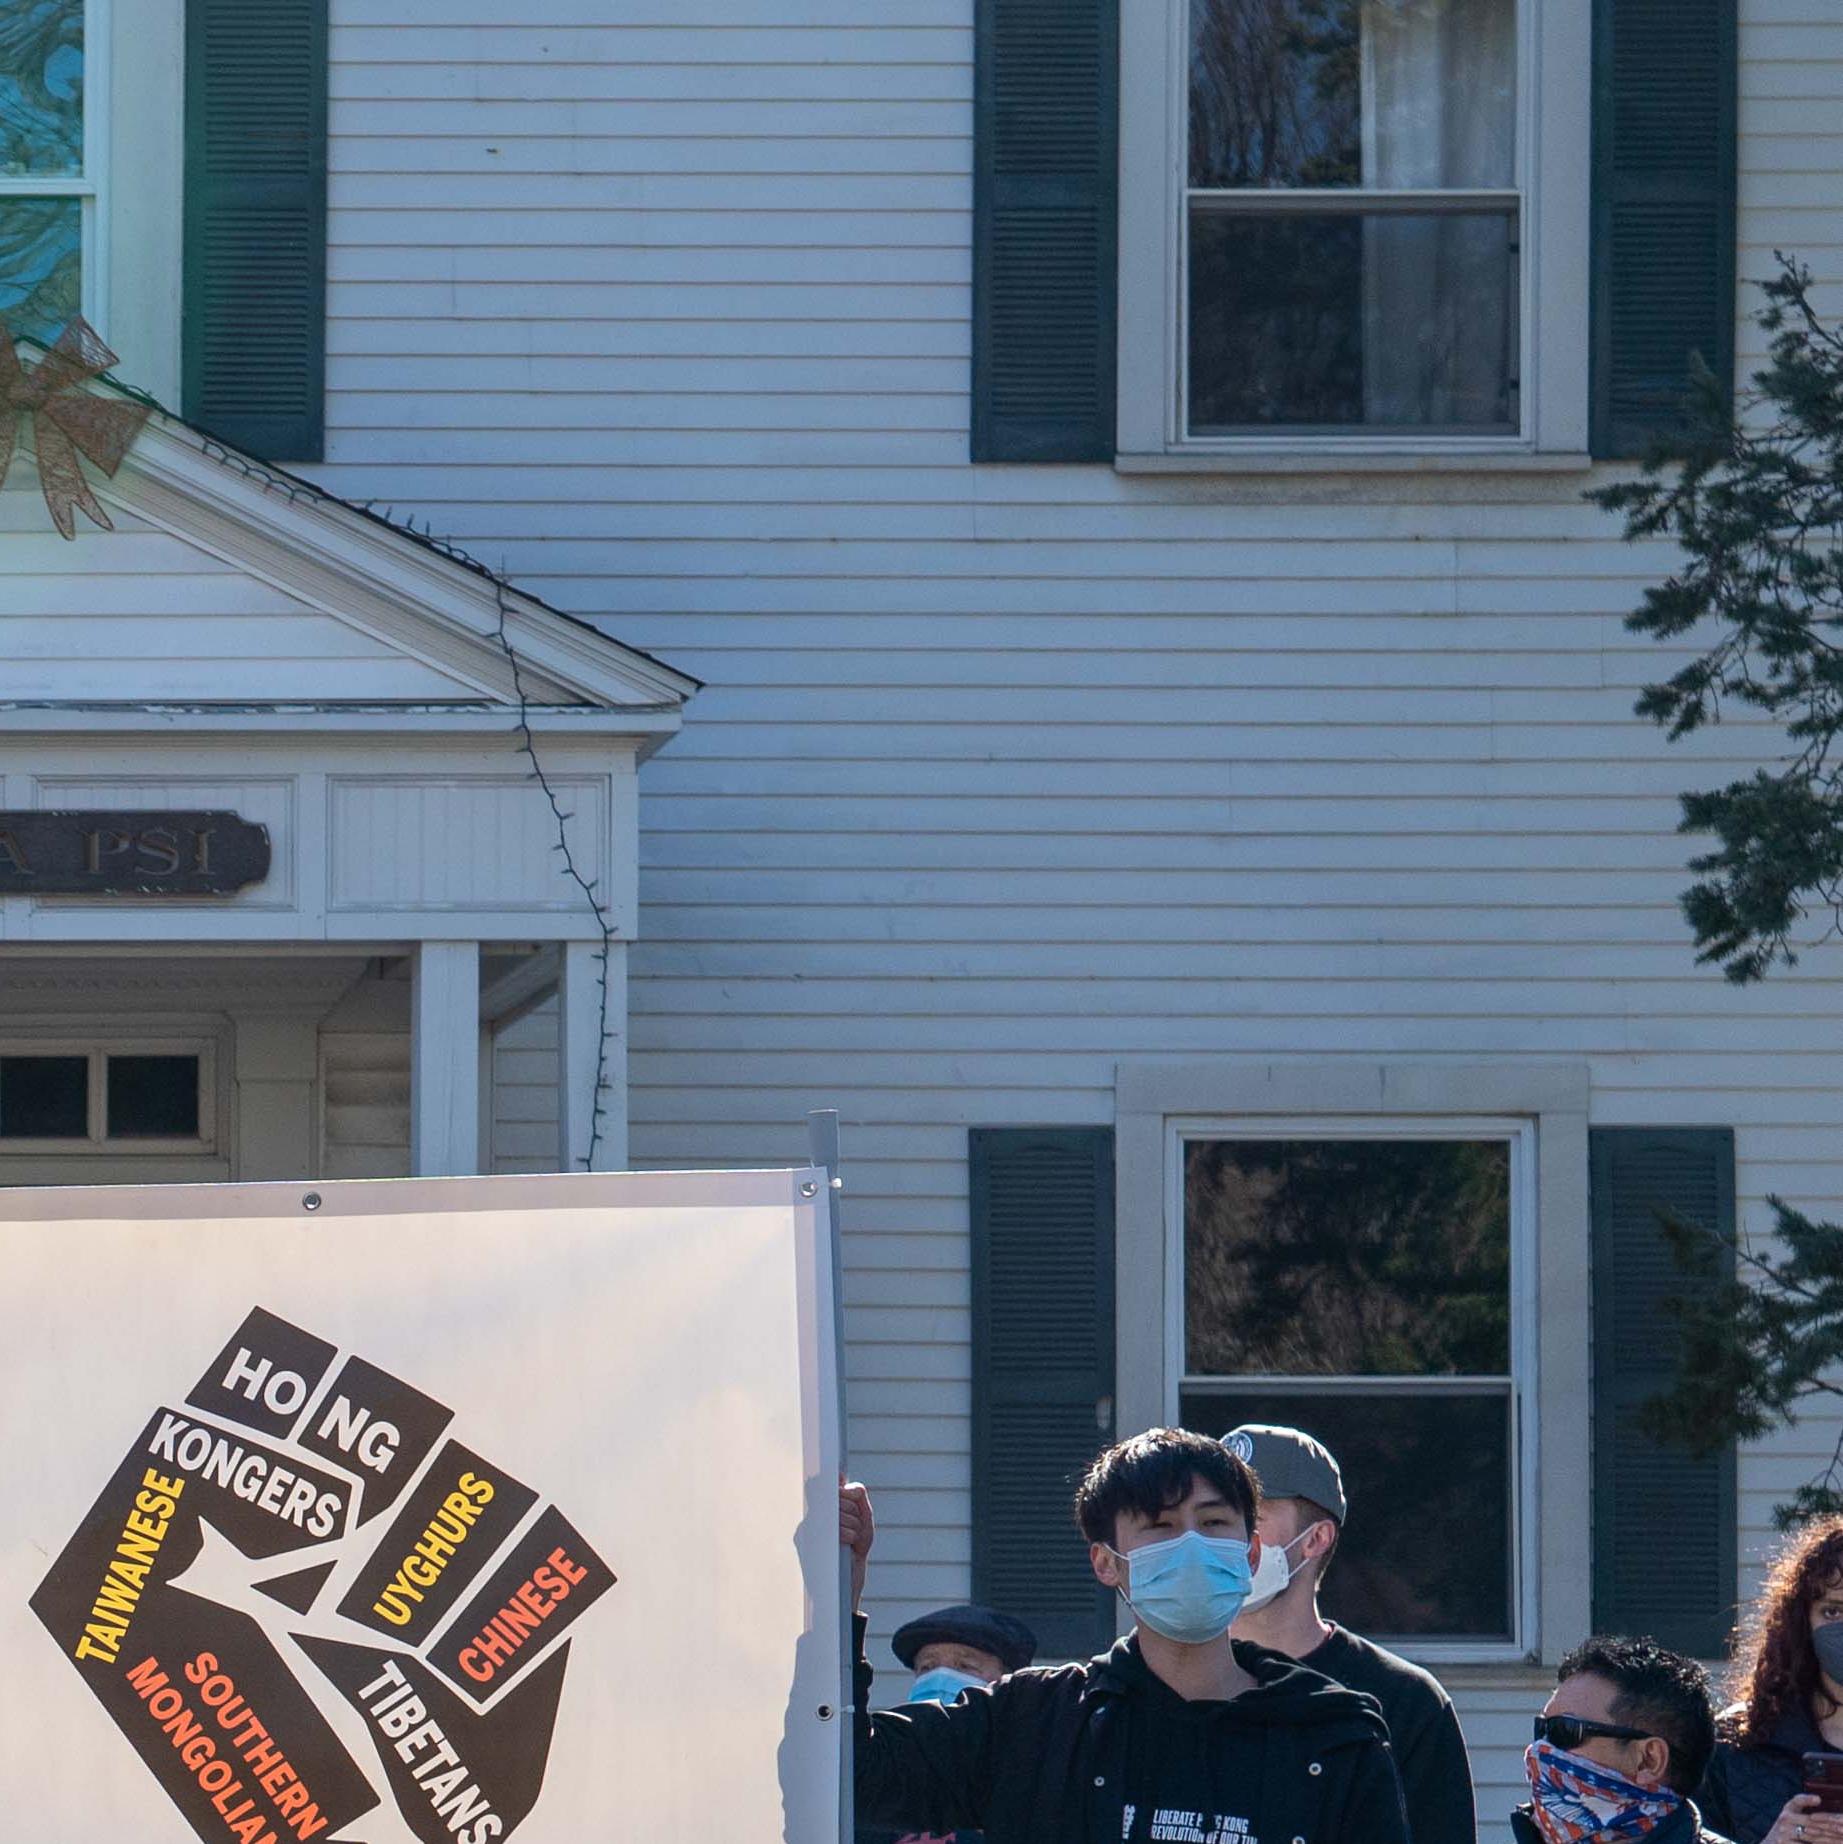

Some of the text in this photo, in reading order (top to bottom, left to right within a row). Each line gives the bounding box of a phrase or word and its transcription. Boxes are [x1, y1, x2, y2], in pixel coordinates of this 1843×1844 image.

[80, 829, 217, 876] PSI
[148, 1413, 344, 1538] KONGERS
[75, 1467, 186, 1664] TAIWANESE
[373, 1472, 495, 1627] UYGHURS
[458, 1547, 588, 1683] CHINESE
[184, 1652, 329, 1841] SOUTHERN
[1150, 1824, 1205, 1844] REVOLUTION
[1153, 1808, 1196, 1827] LIBERATE
[1223, 1815, 1250, 1834] KONG
